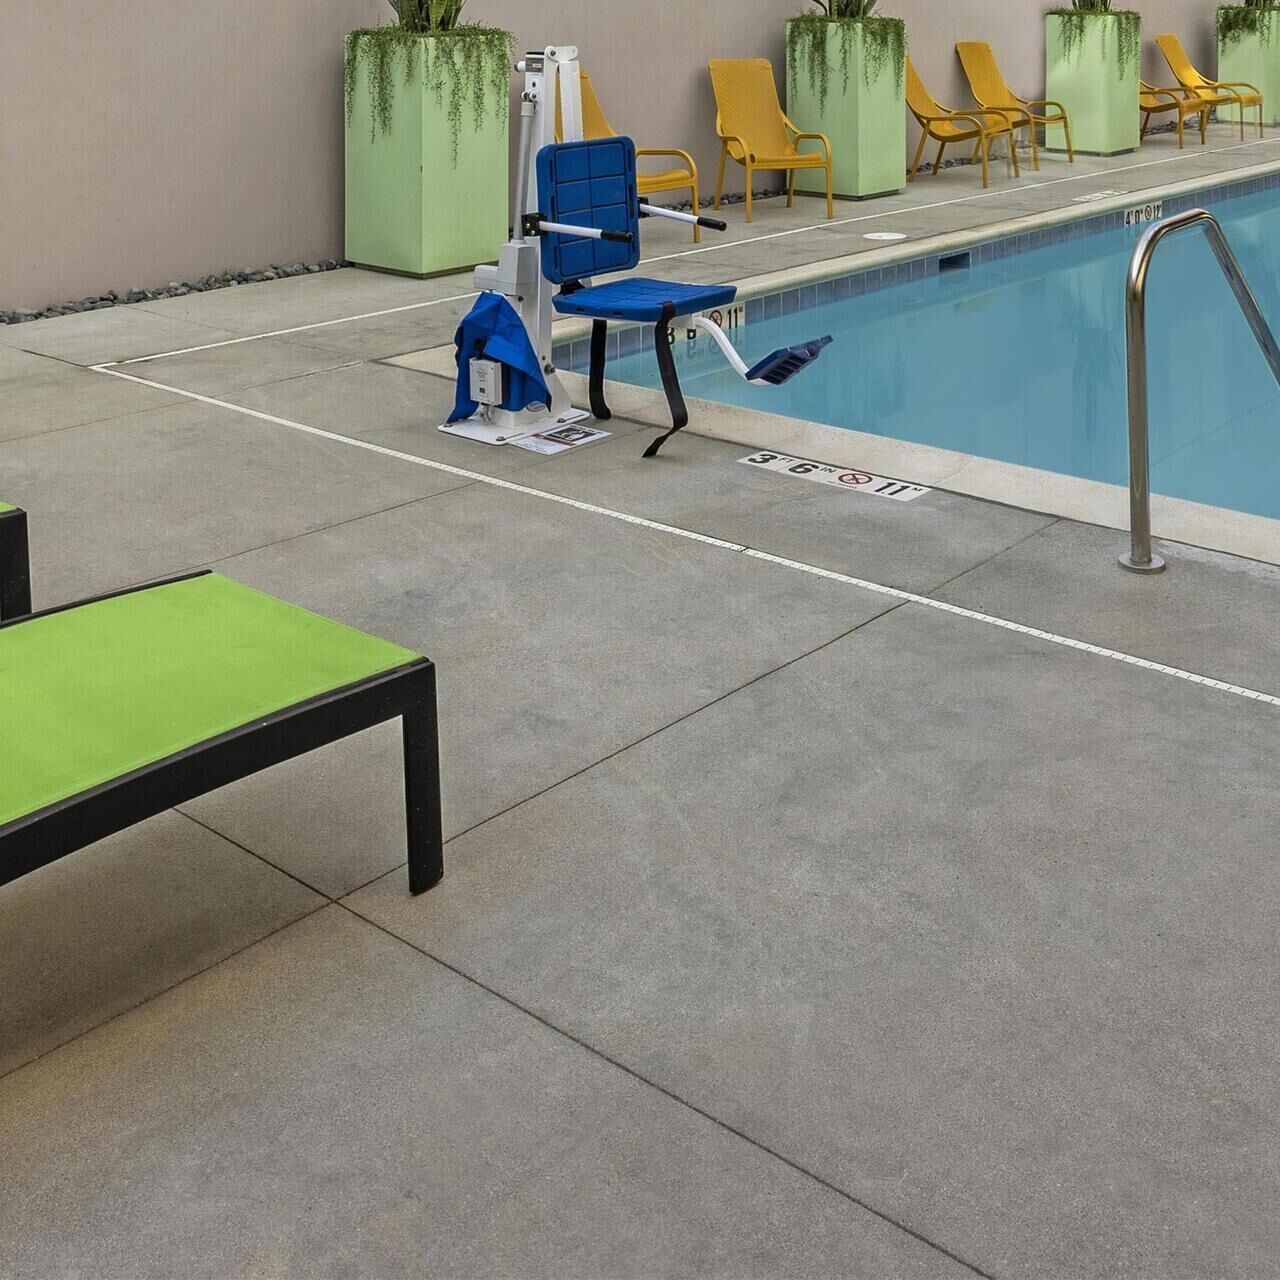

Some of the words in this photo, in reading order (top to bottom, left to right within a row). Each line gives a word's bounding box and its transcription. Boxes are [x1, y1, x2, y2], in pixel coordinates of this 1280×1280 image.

[1125, 211, 1131, 224] 4
[748, 453, 778, 464] 3
[788, 463, 819, 474] 6
